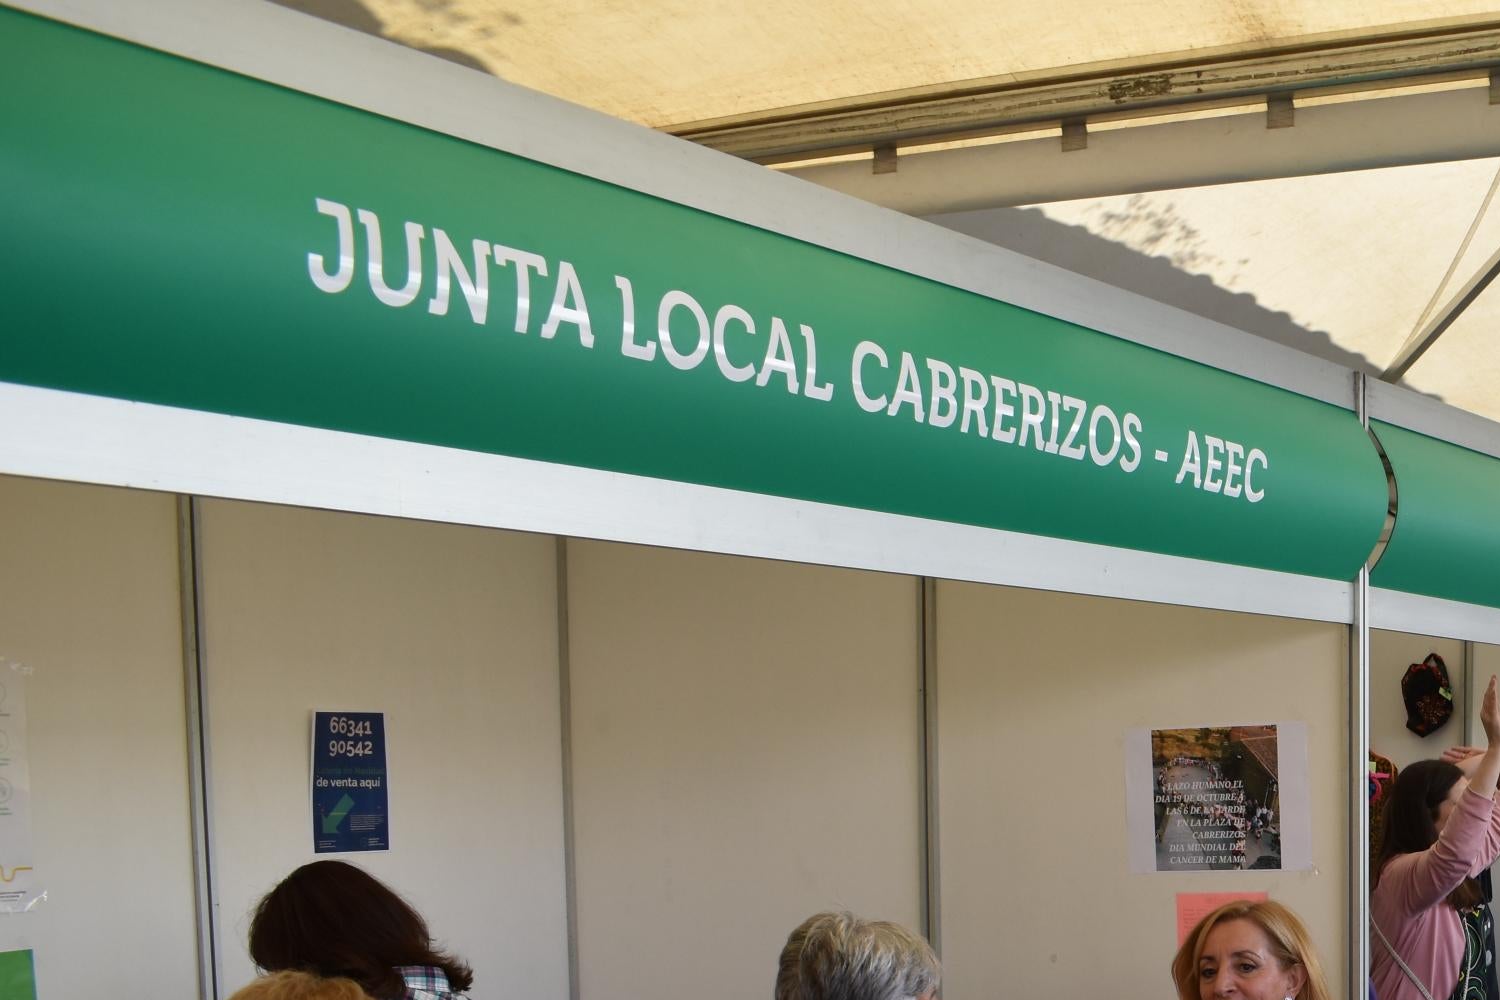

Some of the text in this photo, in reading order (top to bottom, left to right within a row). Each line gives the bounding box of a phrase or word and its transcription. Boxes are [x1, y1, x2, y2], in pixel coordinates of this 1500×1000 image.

[307, 197, 1269, 504] JUNTA LOCAL CABRERIZOS - AEEC
[329, 716, 373, 737] 66341
[329, 740, 373, 757] 90542
[316, 777, 329, 788] de
[330, 777, 358, 788] venta
[1192, 780, 1231, 790] HUMANO
[1231, 780, 1244, 789] EL
[1155, 795, 1171, 803] DIA
[1173, 795, 1182, 803] 19
[1184, 794, 1195, 802] DE
[1196, 793, 1237, 802] OCTUBRE
[1166, 807, 1182, 816] LAS
[1183, 807, 1189, 815] 6
[1190, 806, 1202, 815] DE
[1214, 805, 1246, 814] TARDE
[1190, 818, 1202, 827] LA
[1203, 818, 1232, 827] PLAZA
[1233, 817, 1246, 826] DE
[1192, 830, 1247, 839] CABRERIZOS
[1169, 842, 1246, 852] DIA MUNDIAL DEL
[1170, 855, 1247, 864] CANCER DE MAMA
